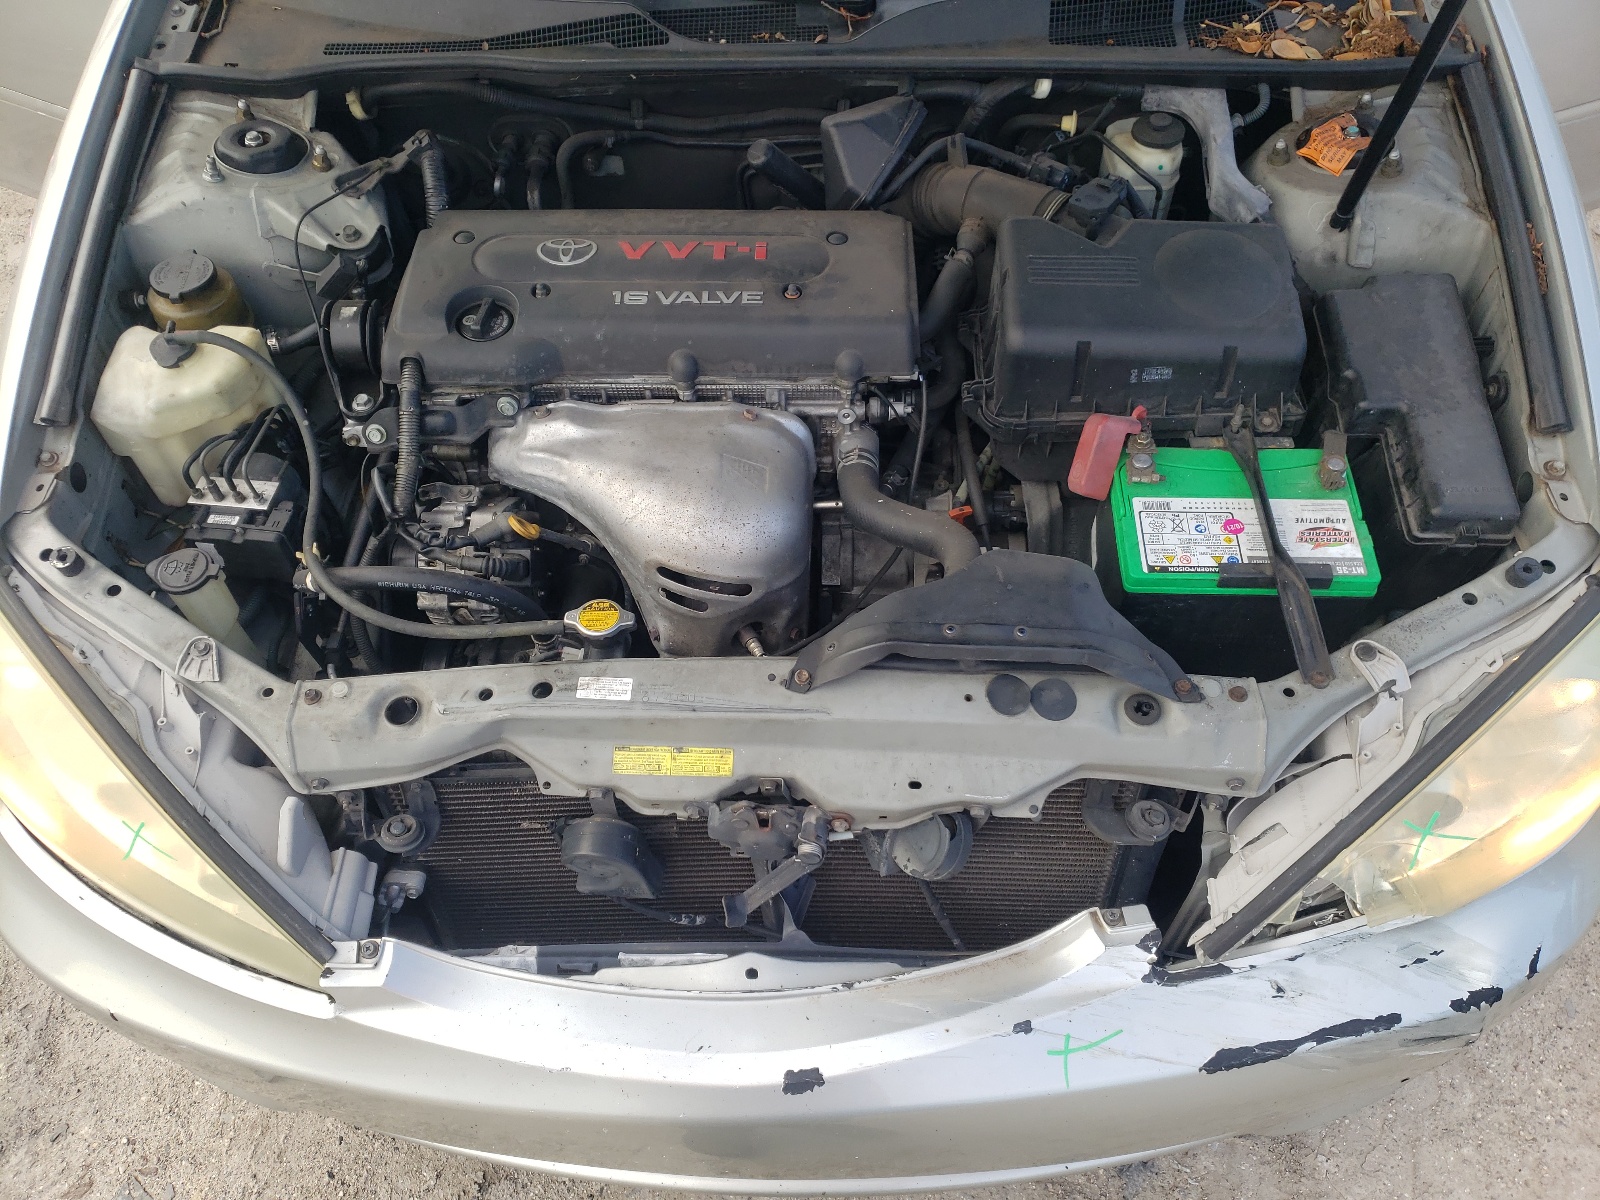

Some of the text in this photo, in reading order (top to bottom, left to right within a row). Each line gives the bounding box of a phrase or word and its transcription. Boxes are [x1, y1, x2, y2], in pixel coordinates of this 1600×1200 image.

[617, 240, 768, 261] VVT-i
[612, 290, 764, 305] 16 VALVE
[1336, 566, 1365, 574] MT-35
